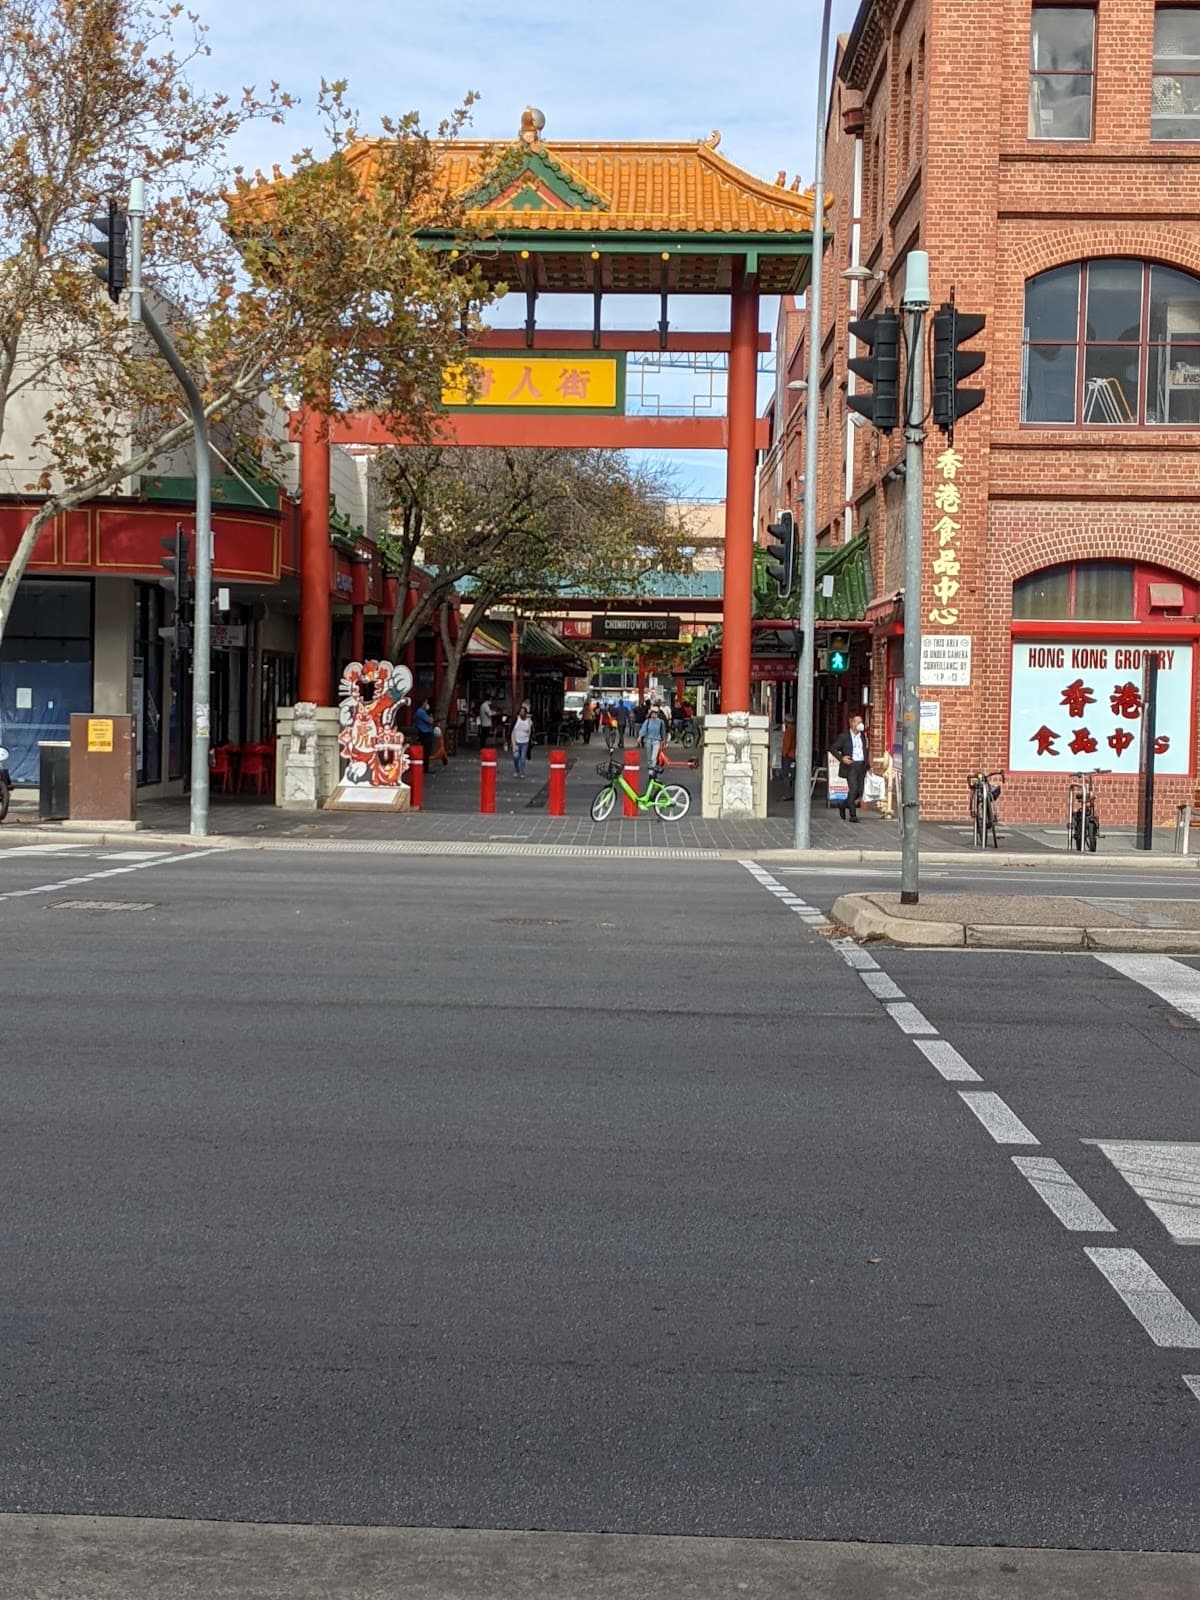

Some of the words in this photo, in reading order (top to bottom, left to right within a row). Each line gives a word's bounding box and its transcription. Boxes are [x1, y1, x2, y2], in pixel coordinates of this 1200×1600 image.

[929, 448, 964, 625] 香港食品中心
[947, 650, 969, 659] CAMERA
[1028, 647, 1065, 669] HONG
[1071, 648, 1108, 669] KONG
[1114, 649, 1175, 670] GRORY
[1059, 678, 1143, 720] 香港
